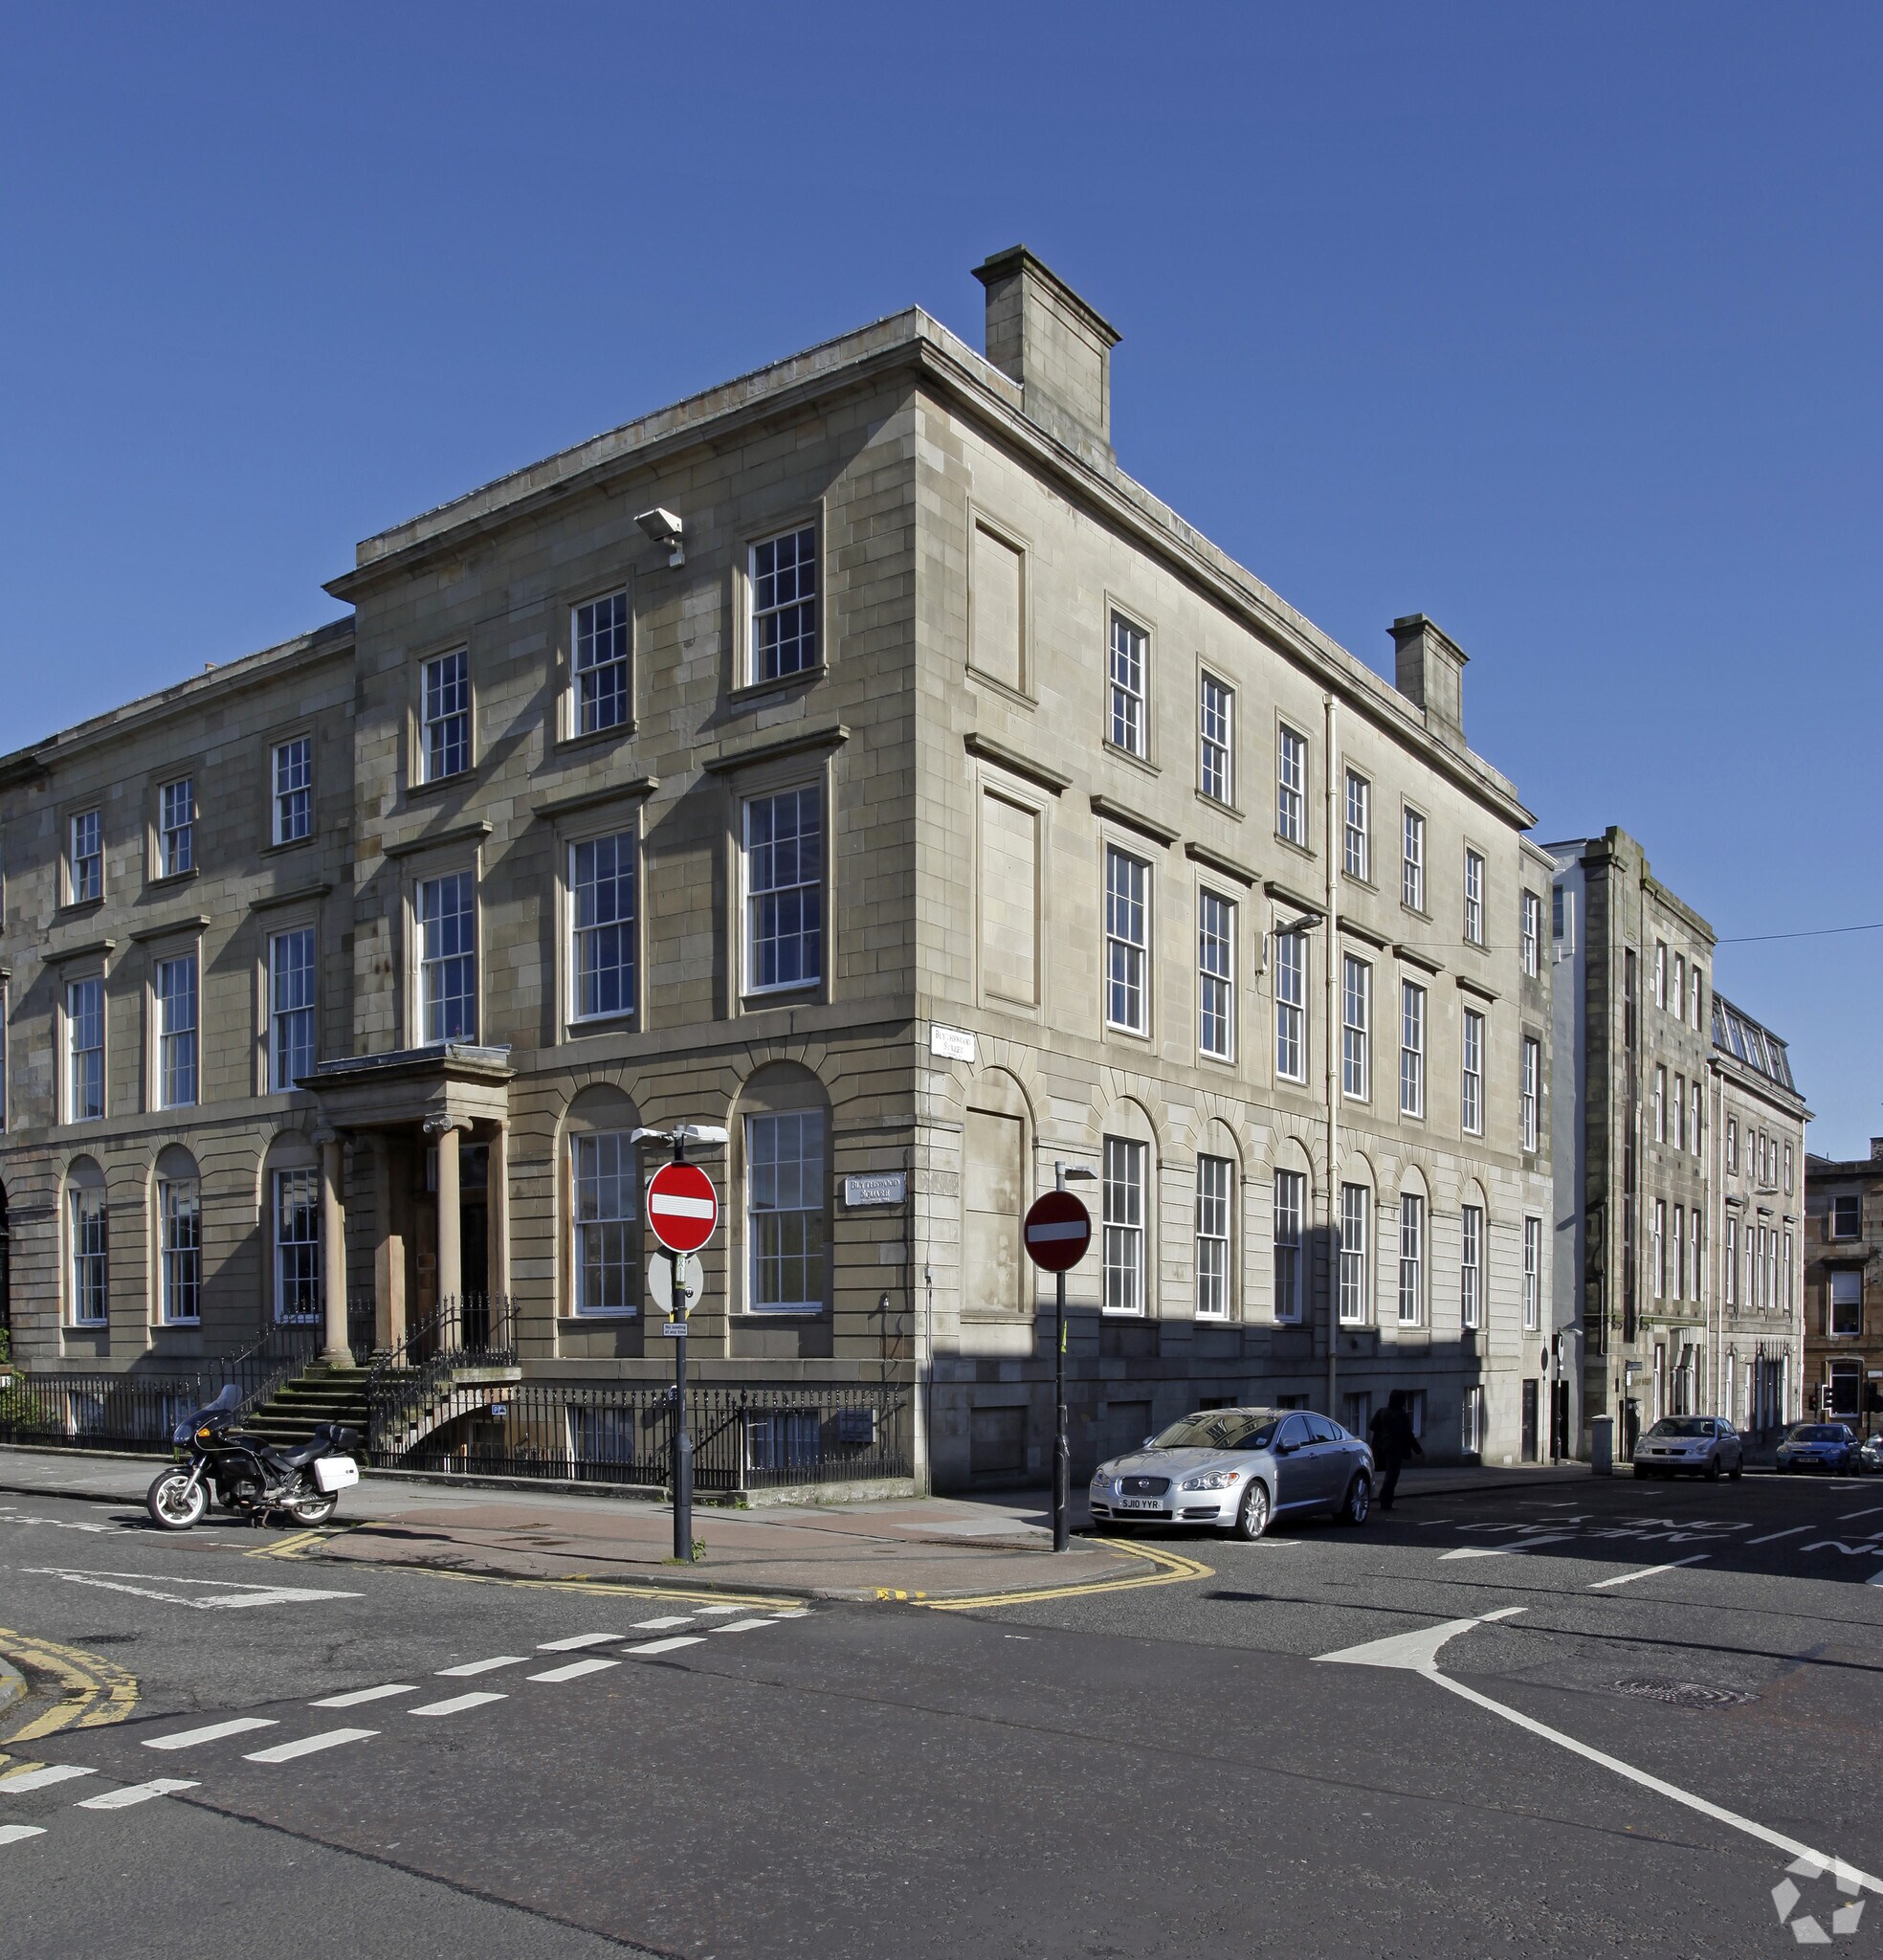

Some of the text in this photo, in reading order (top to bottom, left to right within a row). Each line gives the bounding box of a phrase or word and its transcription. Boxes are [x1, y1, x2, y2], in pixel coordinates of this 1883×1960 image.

[943, 1041, 964, 1054] STREET
[860, 1189, 891, 1199] SQUARE
[1122, 1499, 1158, 1509] SJ10 YYR
